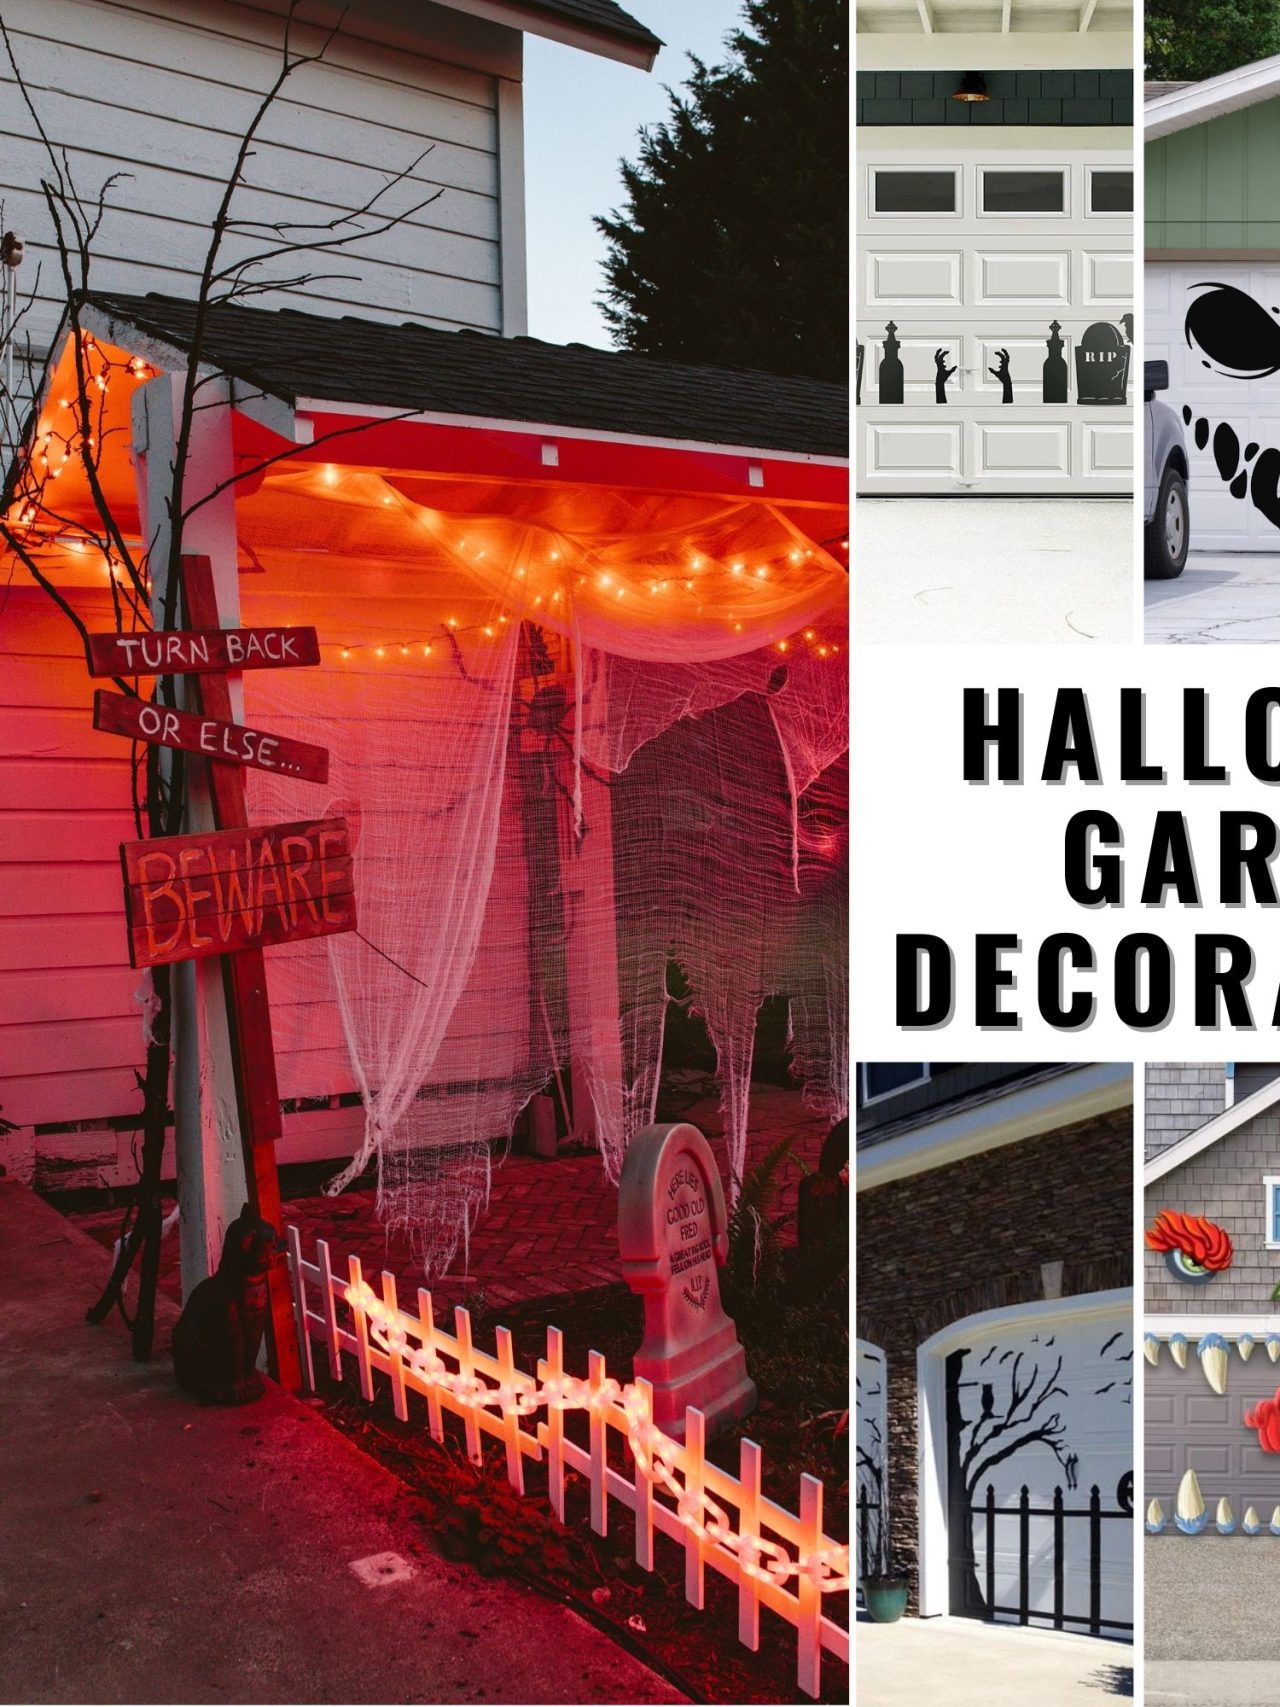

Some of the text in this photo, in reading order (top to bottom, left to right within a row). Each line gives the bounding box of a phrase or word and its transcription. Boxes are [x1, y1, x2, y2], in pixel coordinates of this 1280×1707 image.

[1085, 351, 1117, 363] RIP
[116, 632, 299, 668] TURN BACK
[138, 706, 181, 743] OR
[138, 830, 347, 957] BEWARE
[667, 1168, 699, 1201] HERE LIES
[667, 1198, 705, 1225] GOOD OLD
[680, 1221, 698, 1241] FRED
[671, 1262, 685, 1275] FELL
[684, 1259, 693, 1270] ON
[674, 1247, 691, 1262] GREAT
